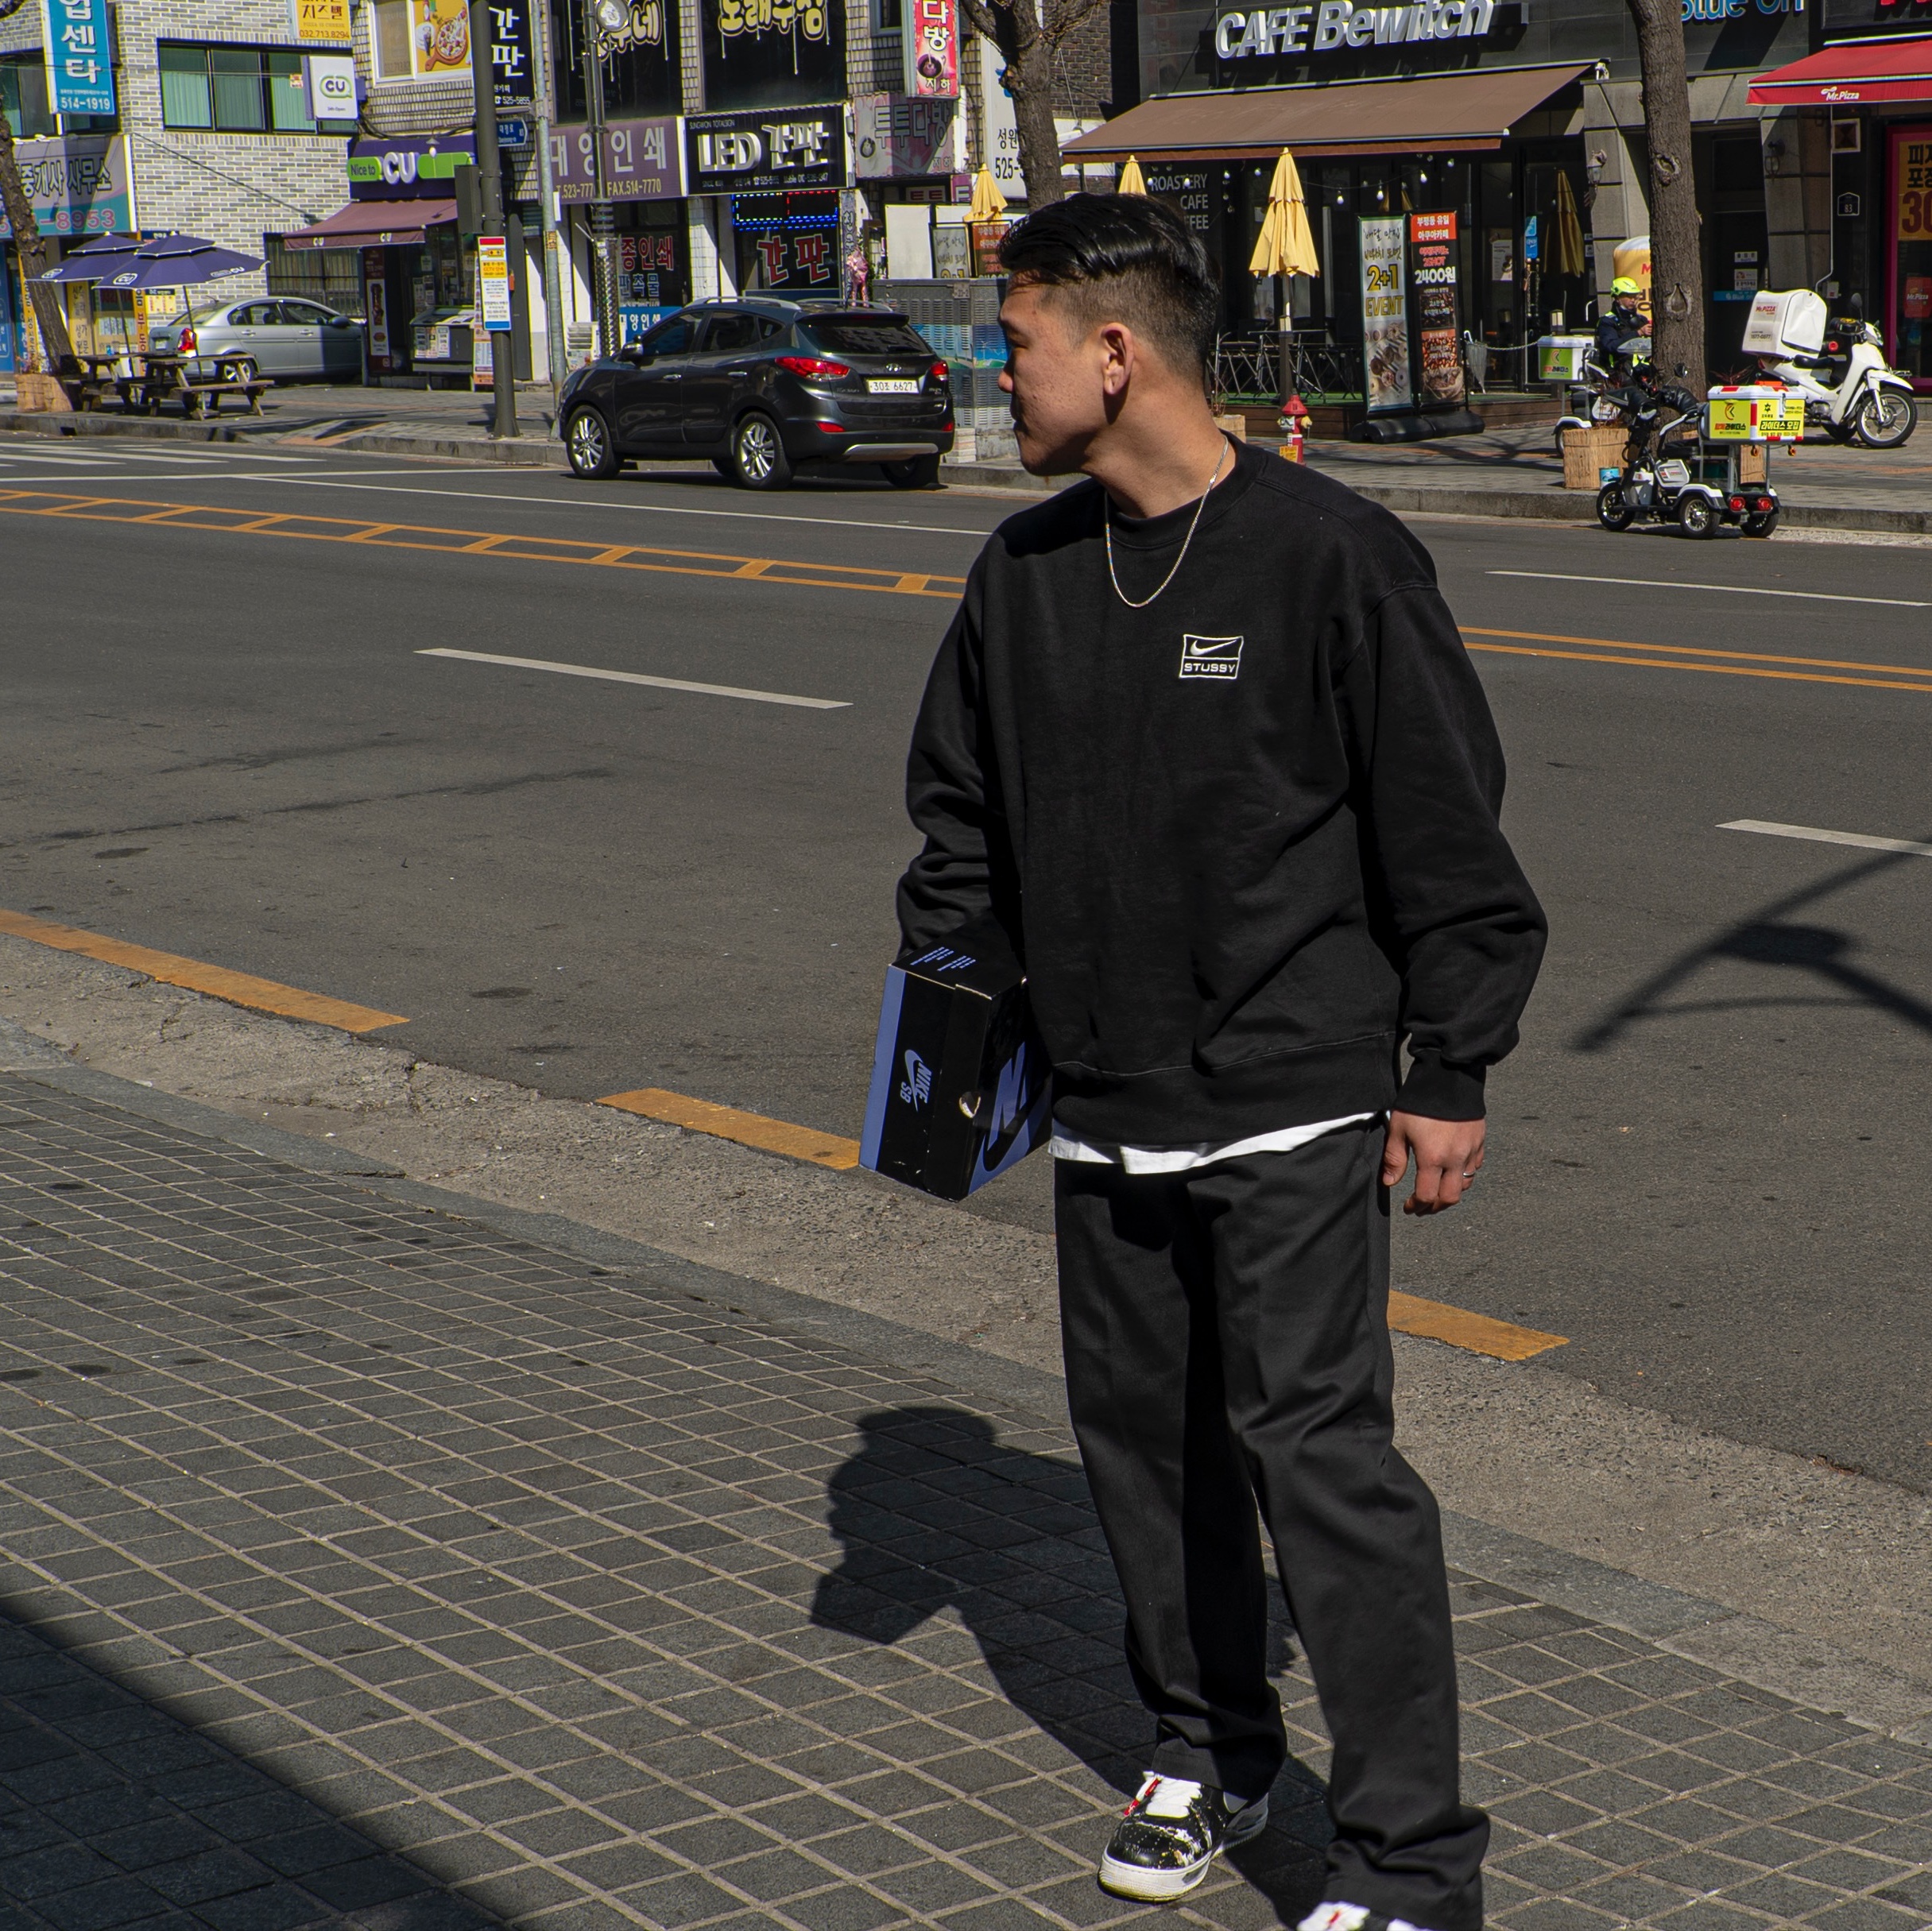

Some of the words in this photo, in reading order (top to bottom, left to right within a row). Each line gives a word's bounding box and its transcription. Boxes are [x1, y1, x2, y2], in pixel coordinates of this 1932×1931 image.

[299, 29, 350, 39] 032.713.8294
[923, 0, 950, 51] 다방
[1215, 6, 1313, 59] CAFE
[1313, 0, 1494, 51] Bewitch
[489, 6, 525, 77] 간판
[325, 80, 345, 92] CU
[926, 79, 951, 92] 지하
[60, 97, 110, 110] 514-1919
[1826, 90, 1860, 101] Mr.Pizza
[875, 101, 952, 149] 투투다방
[698, 132, 761, 172] LED
[761, 122, 829, 169] 간판
[16, 160, 64, 198] 중개사
[67, 157, 112, 195] 사무소
[350, 164, 366, 176] Nice
[368, 165, 376, 176] to
[383, 152, 416, 185] CU
[556, 184, 595, 199] T.523-777
[607, 178, 661, 196] FAX.514-7770
[1180, 194, 1209, 210] CAFE
[1845, 204, 1853, 213] 83
[32, 208, 116, 231] -8953
[1184, 215, 1209, 230] FFEE
[1416, 216, 1436, 226] 부평동
[1437, 215, 1450, 226] 유일
[313, 238, 324, 246] CU
[380, 233, 392, 242] CU
[757, 234, 830, 286] 간판
[1366, 264, 1399, 292] 2+1
[1414, 266, 1456, 284] 2400원
[619, 273, 660, 297] 판촉물
[1365, 295, 1404, 317] EVENT
[894, 381, 912, 391] 6627
[1760, 421, 1783, 431] 라이더스
[1786, 421, 1799, 431] 모집
[1183, 663, 1236, 673] STUSSY
[915, 1062, 932, 1104] NIKE
[900, 1082, 912, 1104] SB
